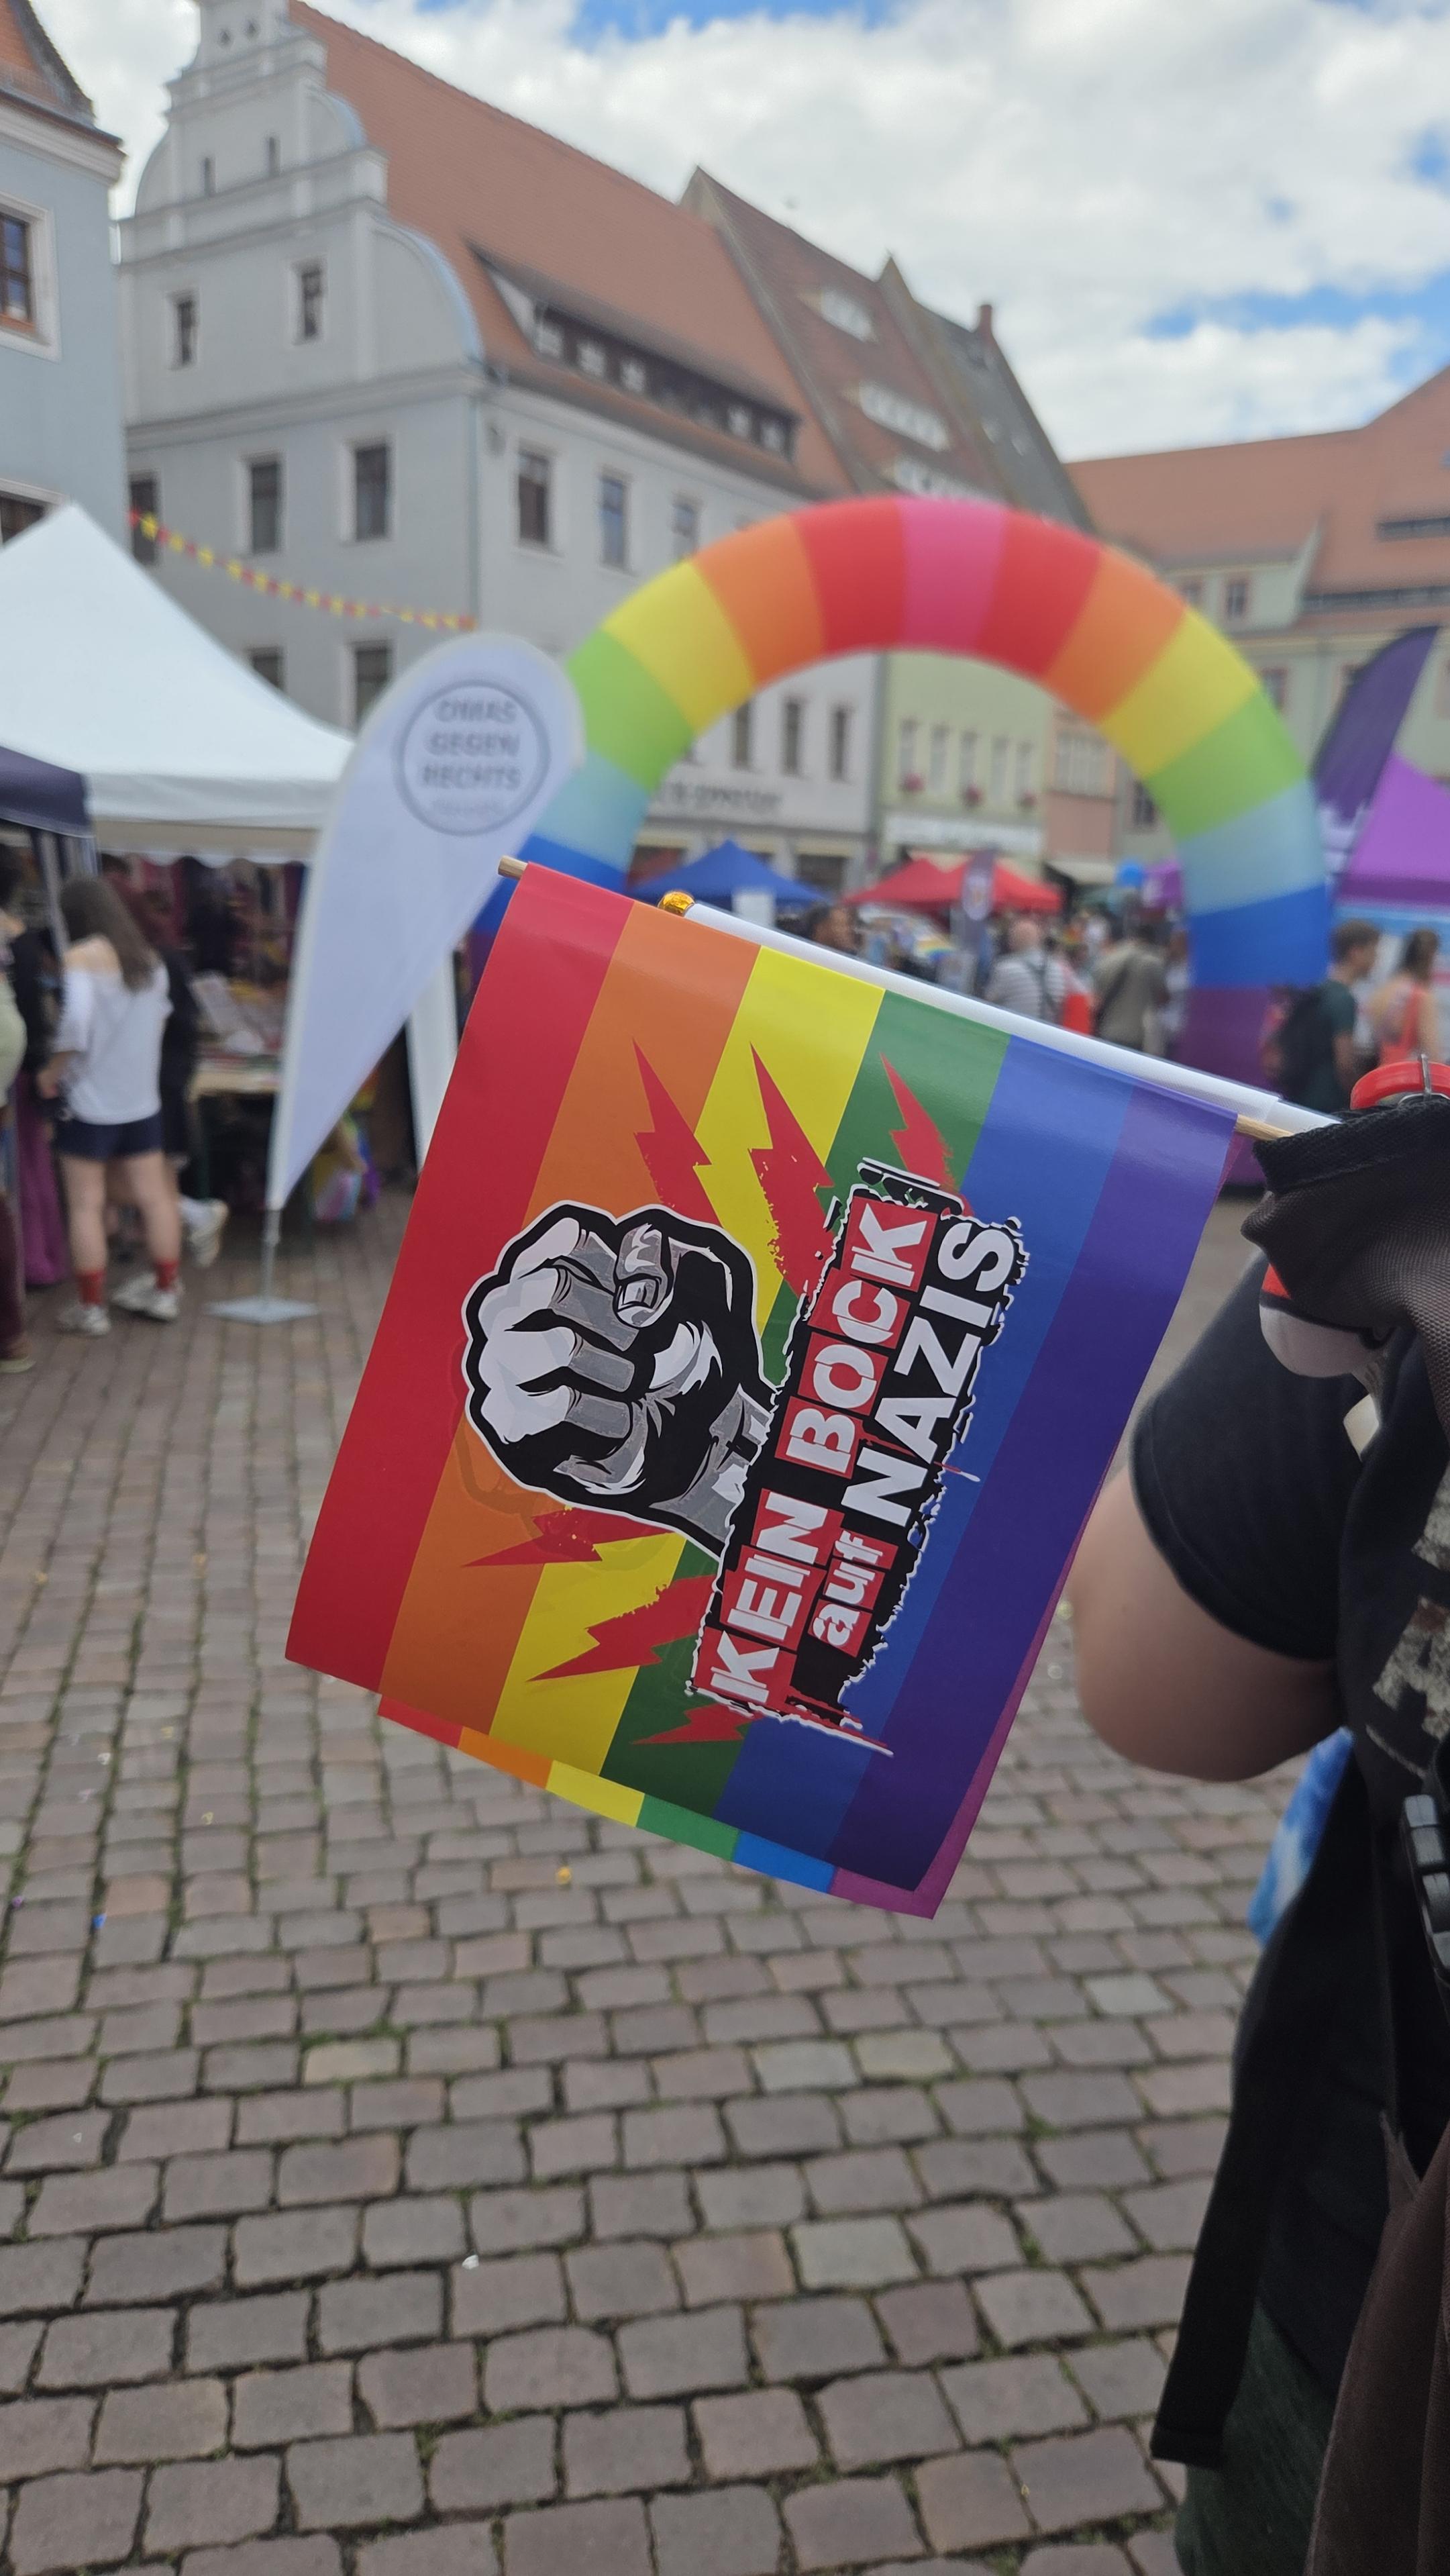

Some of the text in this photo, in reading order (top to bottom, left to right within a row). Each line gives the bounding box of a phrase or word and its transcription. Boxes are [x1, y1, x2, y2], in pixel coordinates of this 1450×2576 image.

[711, 1203, 927, 1703] KEIN BOCK
[812, 1222, 1014, 1646] auf NAZIS
